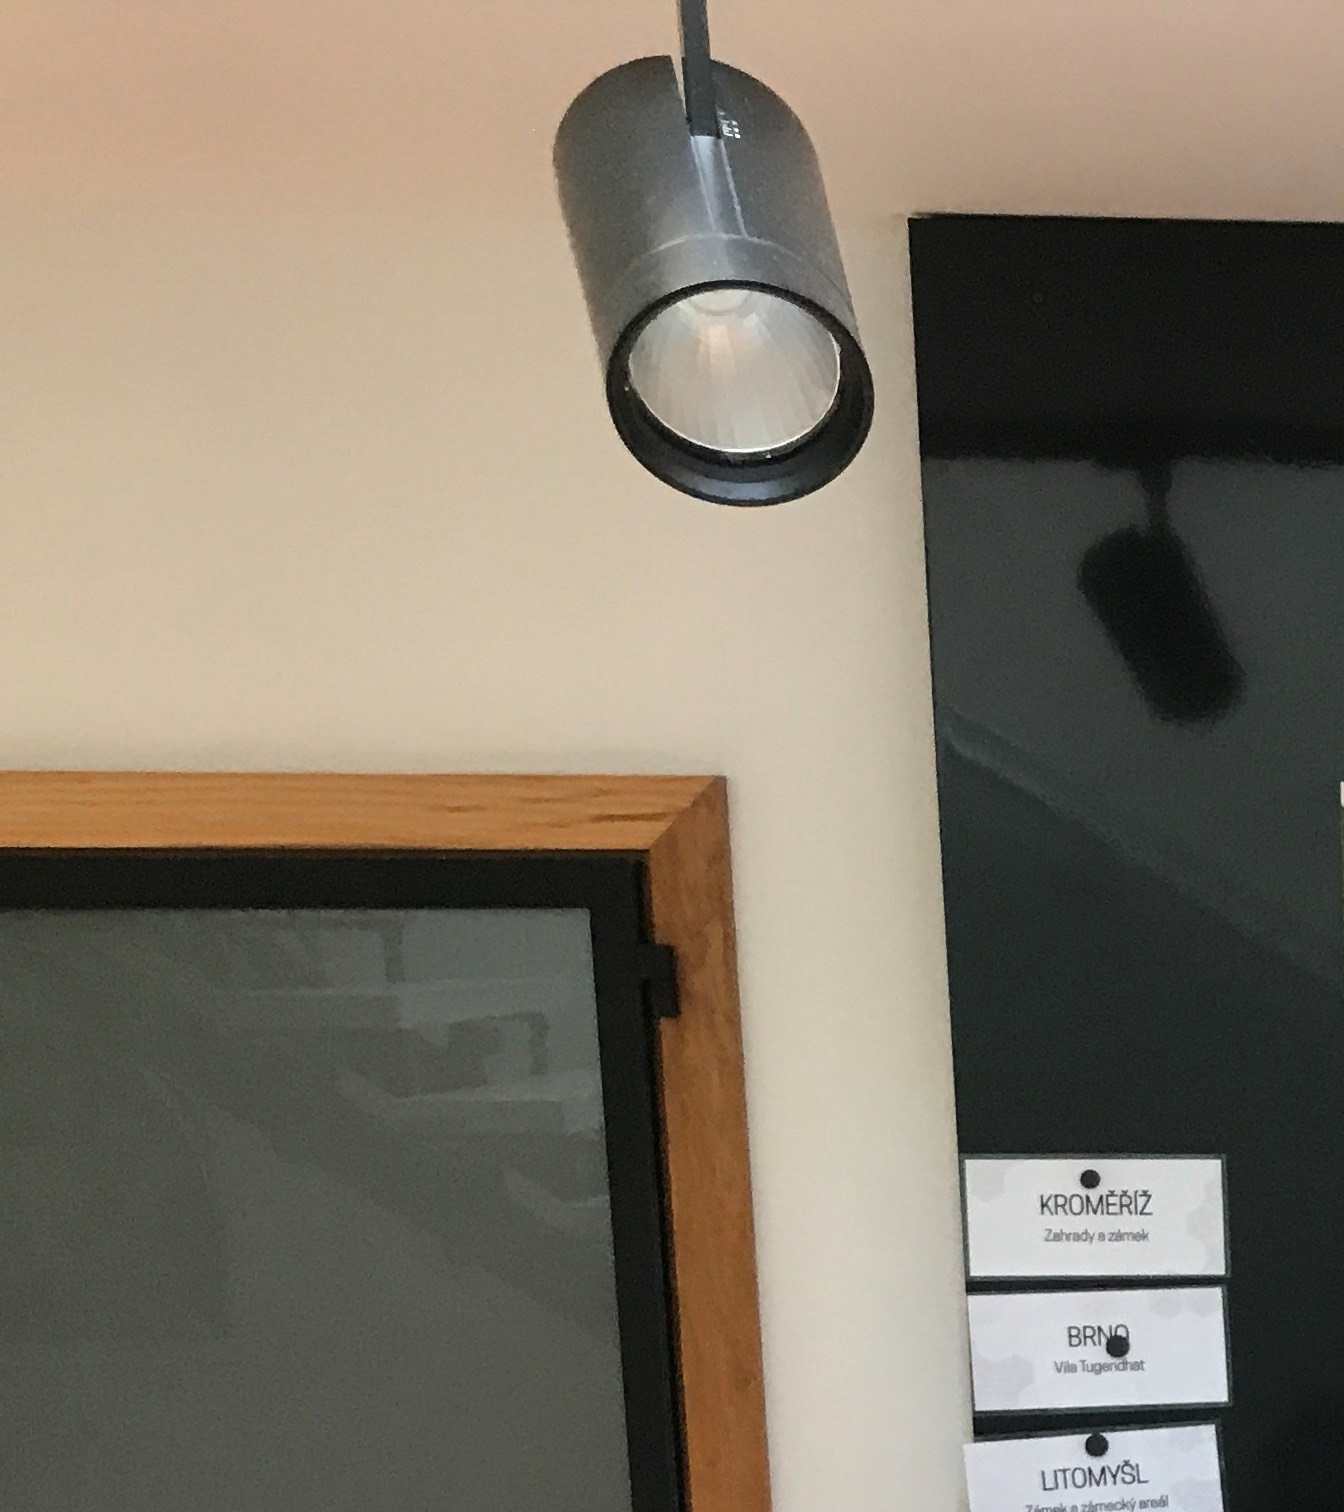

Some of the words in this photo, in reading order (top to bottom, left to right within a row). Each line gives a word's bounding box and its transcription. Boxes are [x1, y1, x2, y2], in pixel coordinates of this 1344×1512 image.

[1040, 1190, 1153, 1216] KROMĚŘÍŽ
[1044, 1228, 1095, 1245] Zahrady
[1097, 1232, 1106, 1242] a
[1109, 1229, 1149, 1242] zámek
[1054, 1360, 1078, 1374] Vila
[1079, 1359, 1145, 1375] Tugendhat
[1041, 1460, 1149, 1491] LITOMYŠL
[1139, 1495, 1169, 1509] areál
